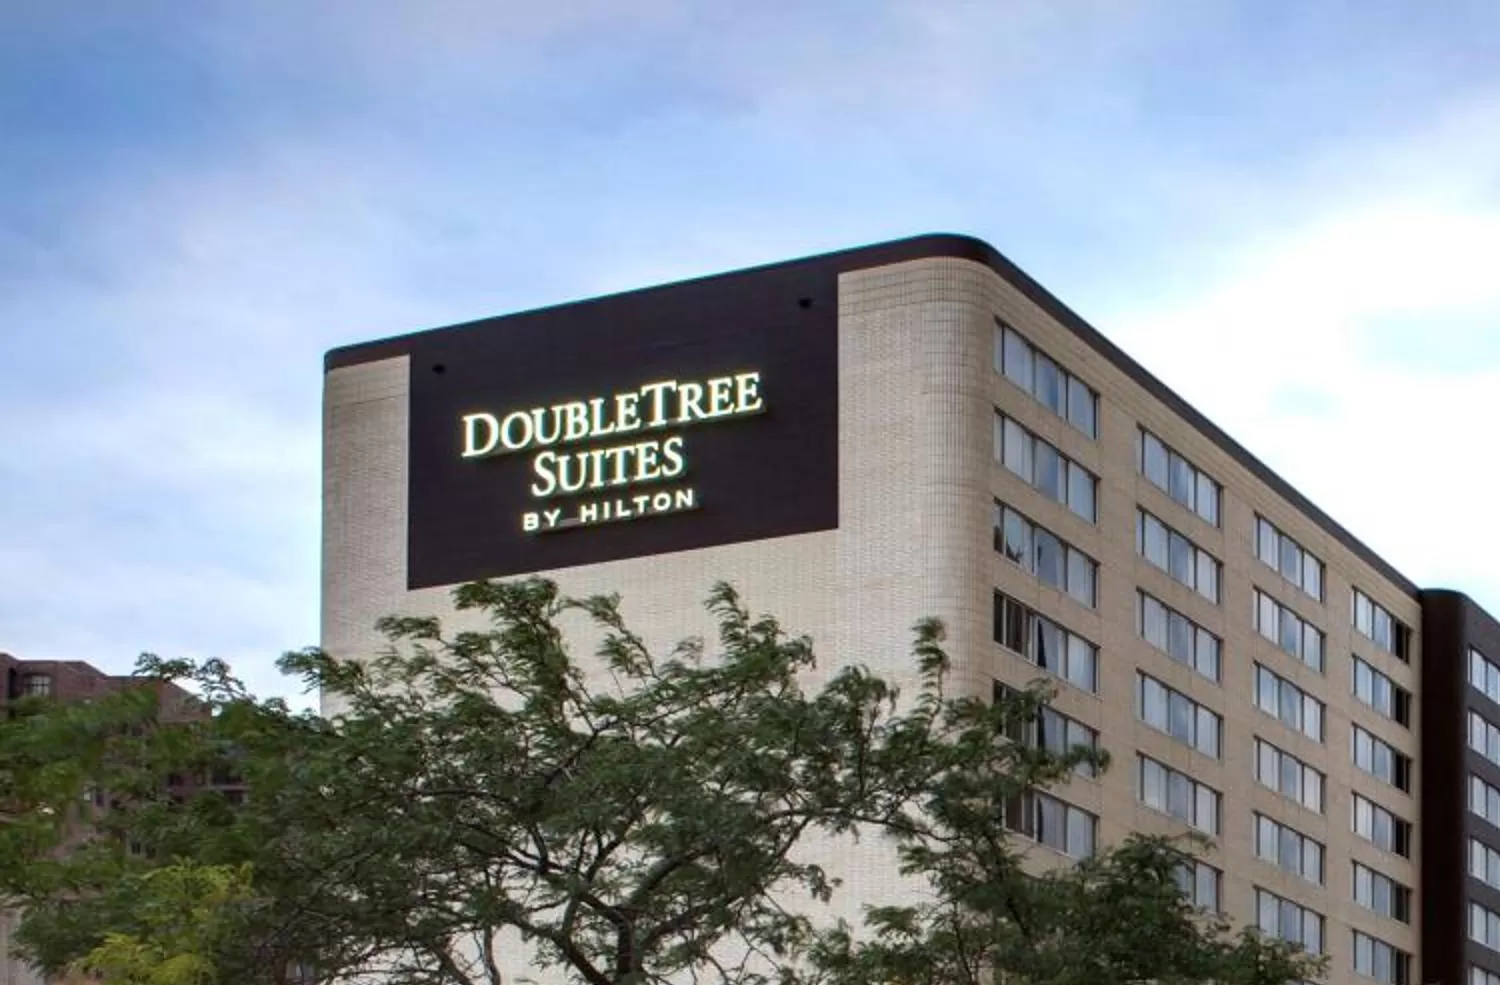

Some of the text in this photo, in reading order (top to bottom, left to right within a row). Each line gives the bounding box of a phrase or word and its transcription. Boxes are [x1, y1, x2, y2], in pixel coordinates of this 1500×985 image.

[531, 436, 685, 497] SUITES
[522, 488, 695, 532] BY HILTON
